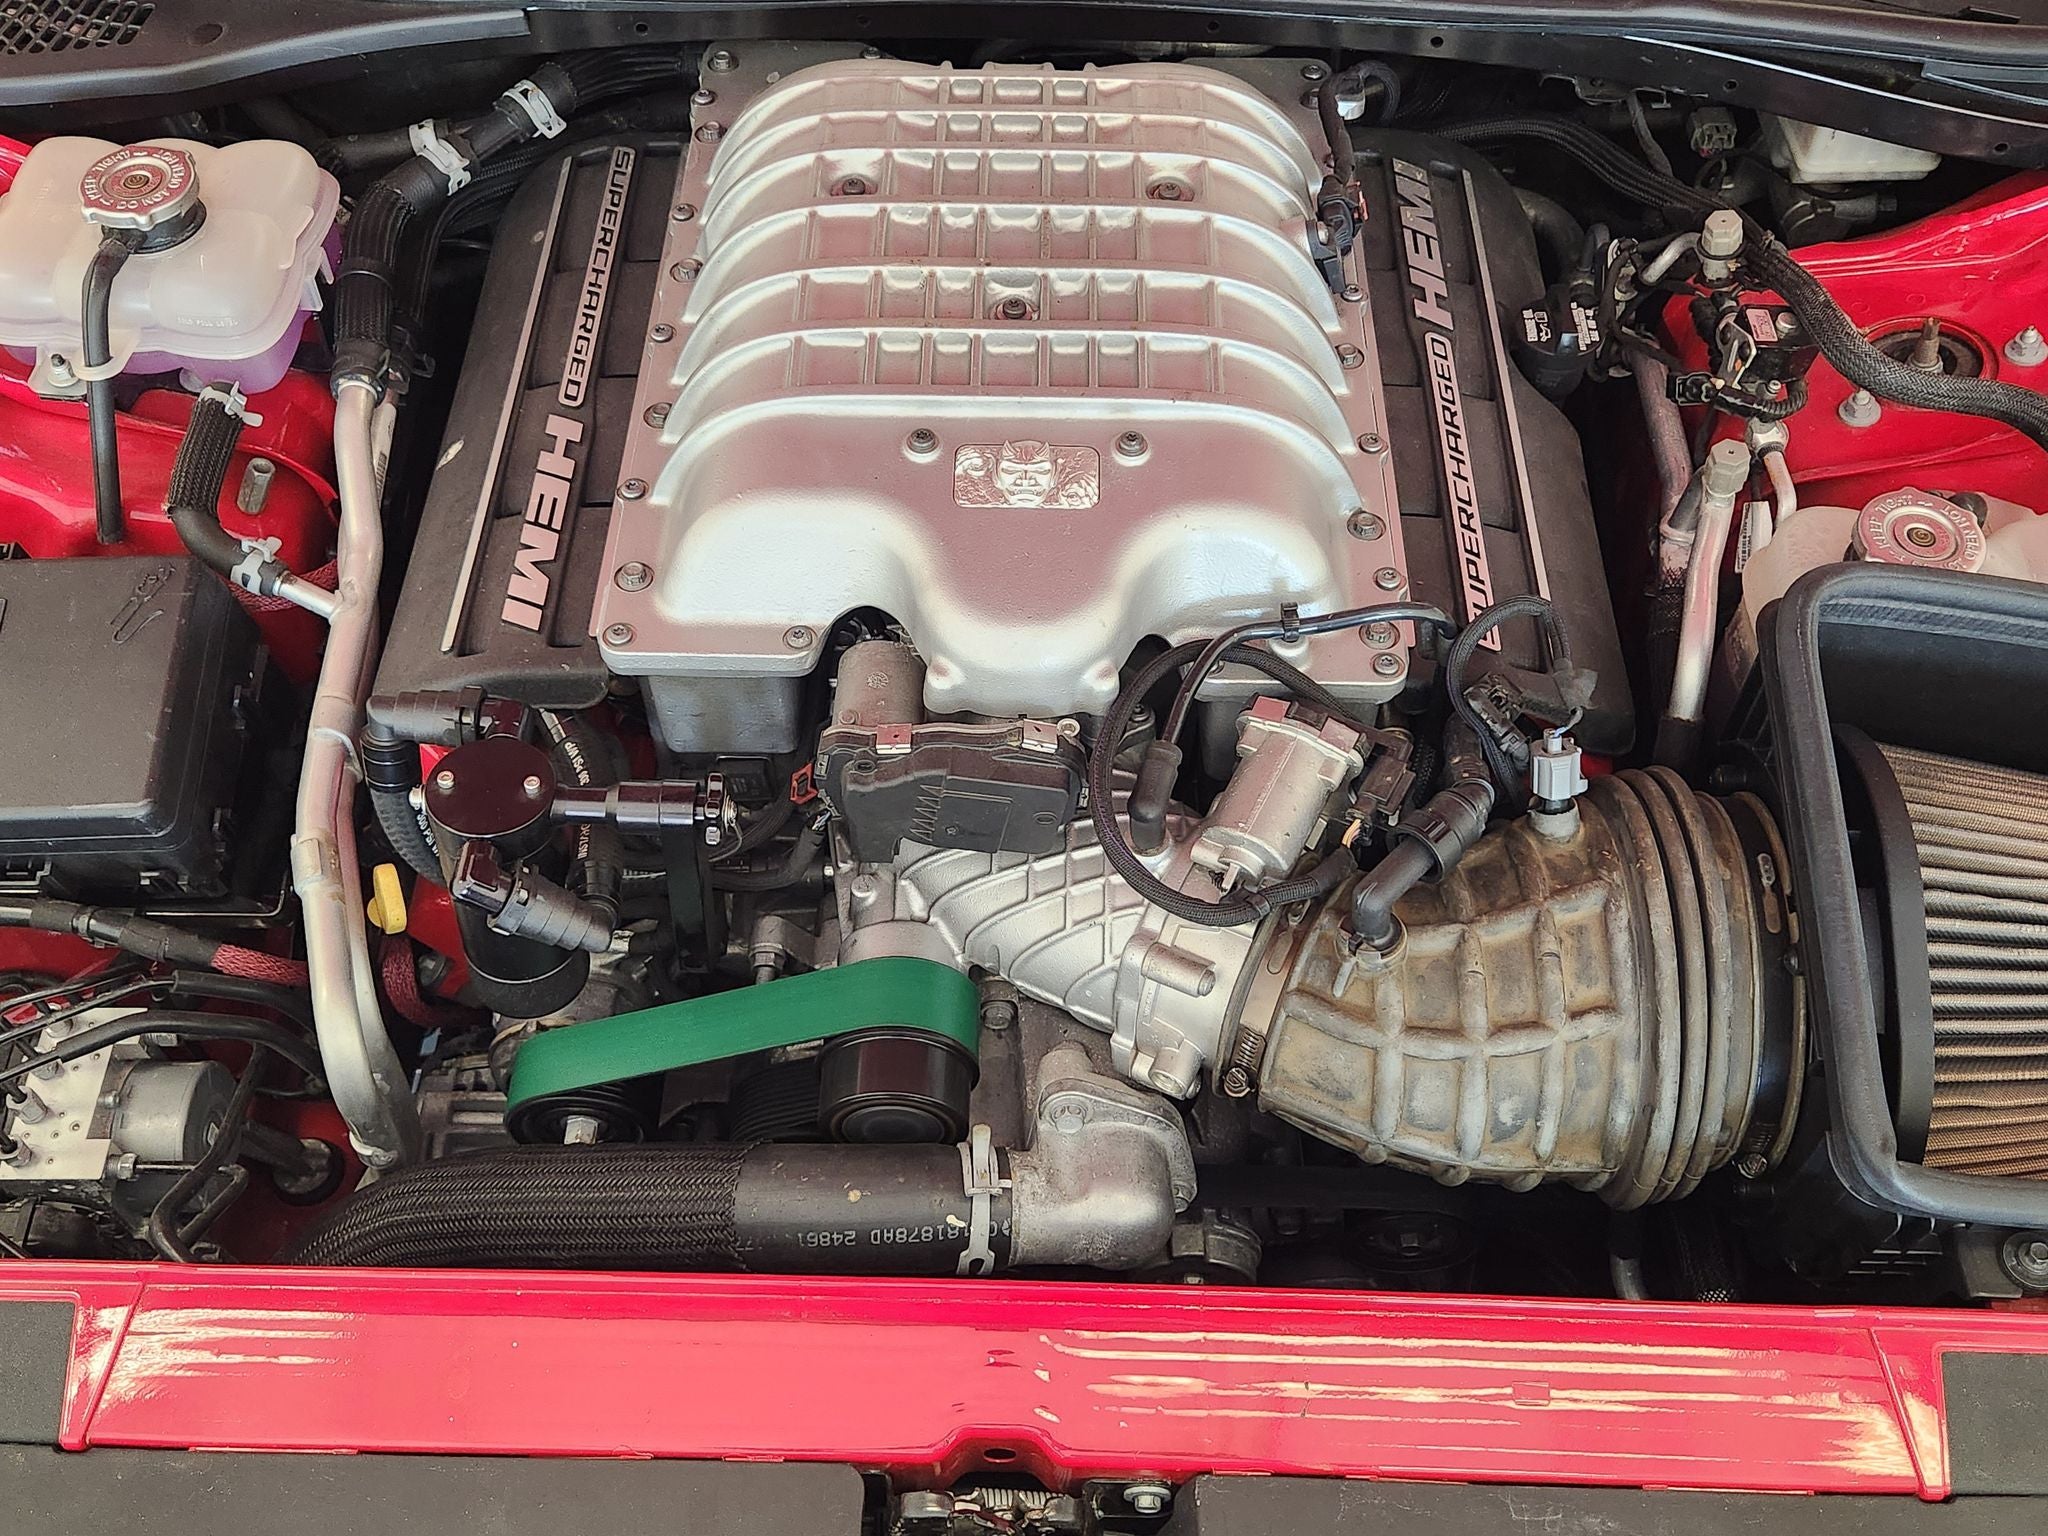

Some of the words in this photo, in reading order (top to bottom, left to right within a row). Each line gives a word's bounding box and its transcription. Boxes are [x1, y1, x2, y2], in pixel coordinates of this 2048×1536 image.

[84, 174, 101, 200] KEEP
[92, 150, 131, 172] TIGHT
[563, 149, 631, 401] SUPERCHARGED
[1393, 157, 1454, 331] HEMI
[501, 413, 584, 632] HEMI
[797, 1229, 857, 1247] 24861
